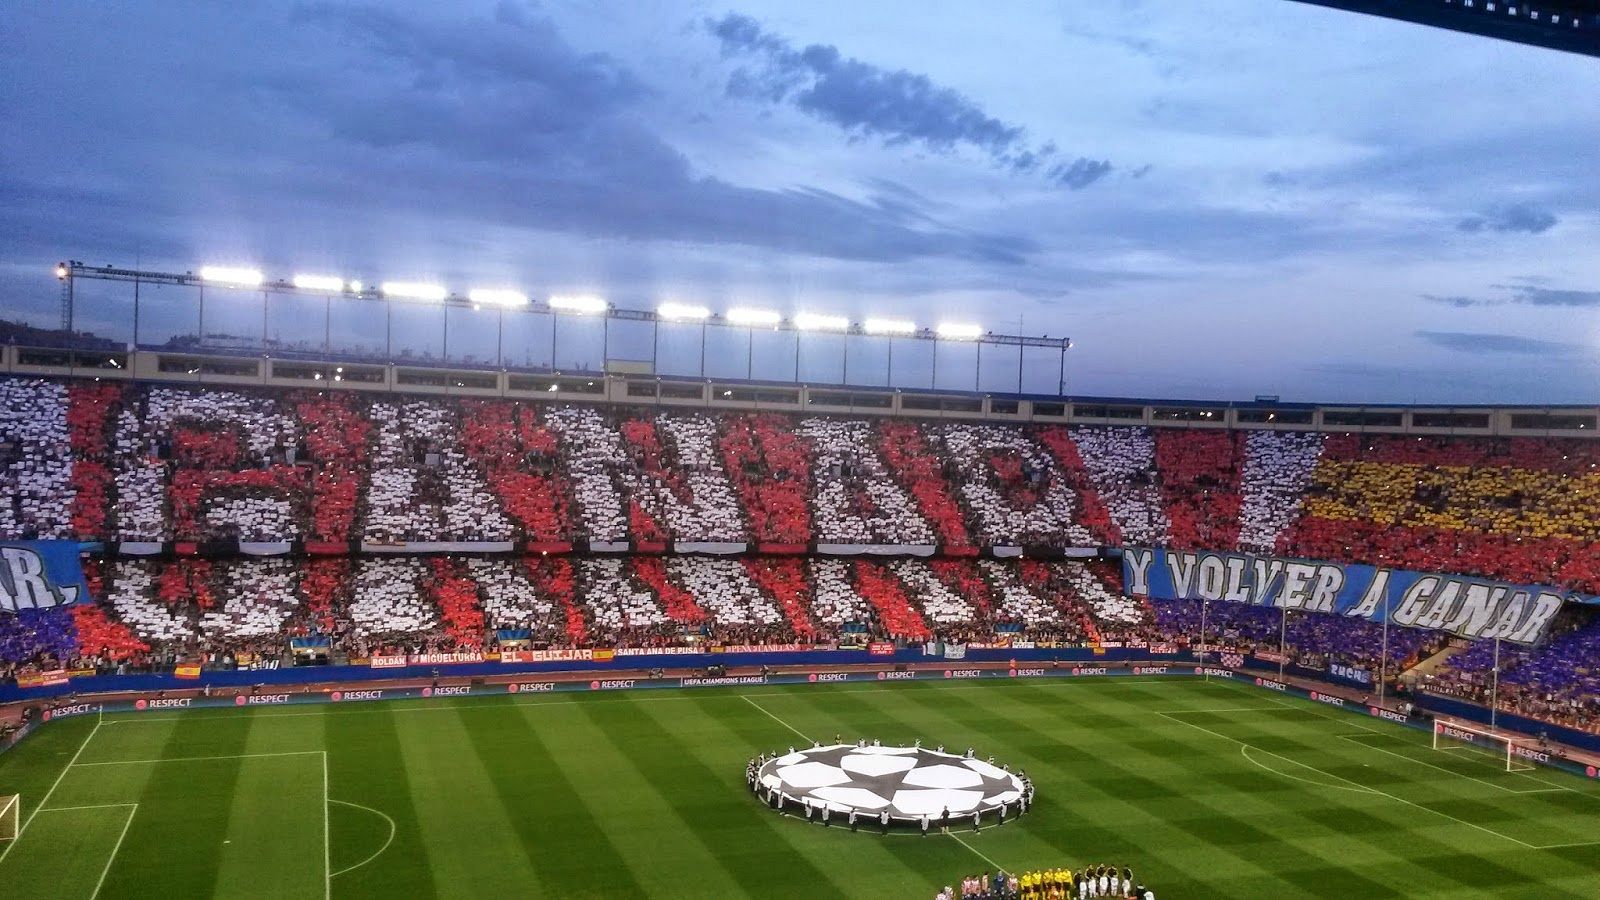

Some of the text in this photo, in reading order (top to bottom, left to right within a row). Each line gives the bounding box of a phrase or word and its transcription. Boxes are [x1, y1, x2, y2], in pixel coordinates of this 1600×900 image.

[1124, 549, 1563, 645] Y VOLVER A GANAR
[501, 649, 593, 663] EL GUIJAR
[617, 648, 645, 656] SANTA
[647, 647, 663, 655] ANA
[665, 647, 676, 655] DE
[372, 656, 406, 667] ROLDÁN
[420, 652, 483, 664] MIGUELTURRA
[818, 673, 848, 681] RESPECT
[886, 671, 915, 679] RESPECT
[1203, 668, 1233, 678] RESPECT
[601, 680, 635, 689] RESPECT
[684, 676, 763, 686] UEFA CHAMPIONS LEAGUE
[1262, 679, 1287, 691] RESPECT
[434, 686, 471, 696] RESPECT
[520, 683, 555, 692] RESPECT
[248, 694, 290, 704] RESPECT
[343, 690, 383, 700] RESPECT
[1318, 693, 1344, 706] RESPECT
[149, 698, 192, 709] RESPECT
[52, 704, 91, 718] RESPECT
[1380, 710, 1408, 723] RESPECT
[1444, 727, 1475, 741] RESPECT
[1515, 747, 1550, 763] RESPECT
